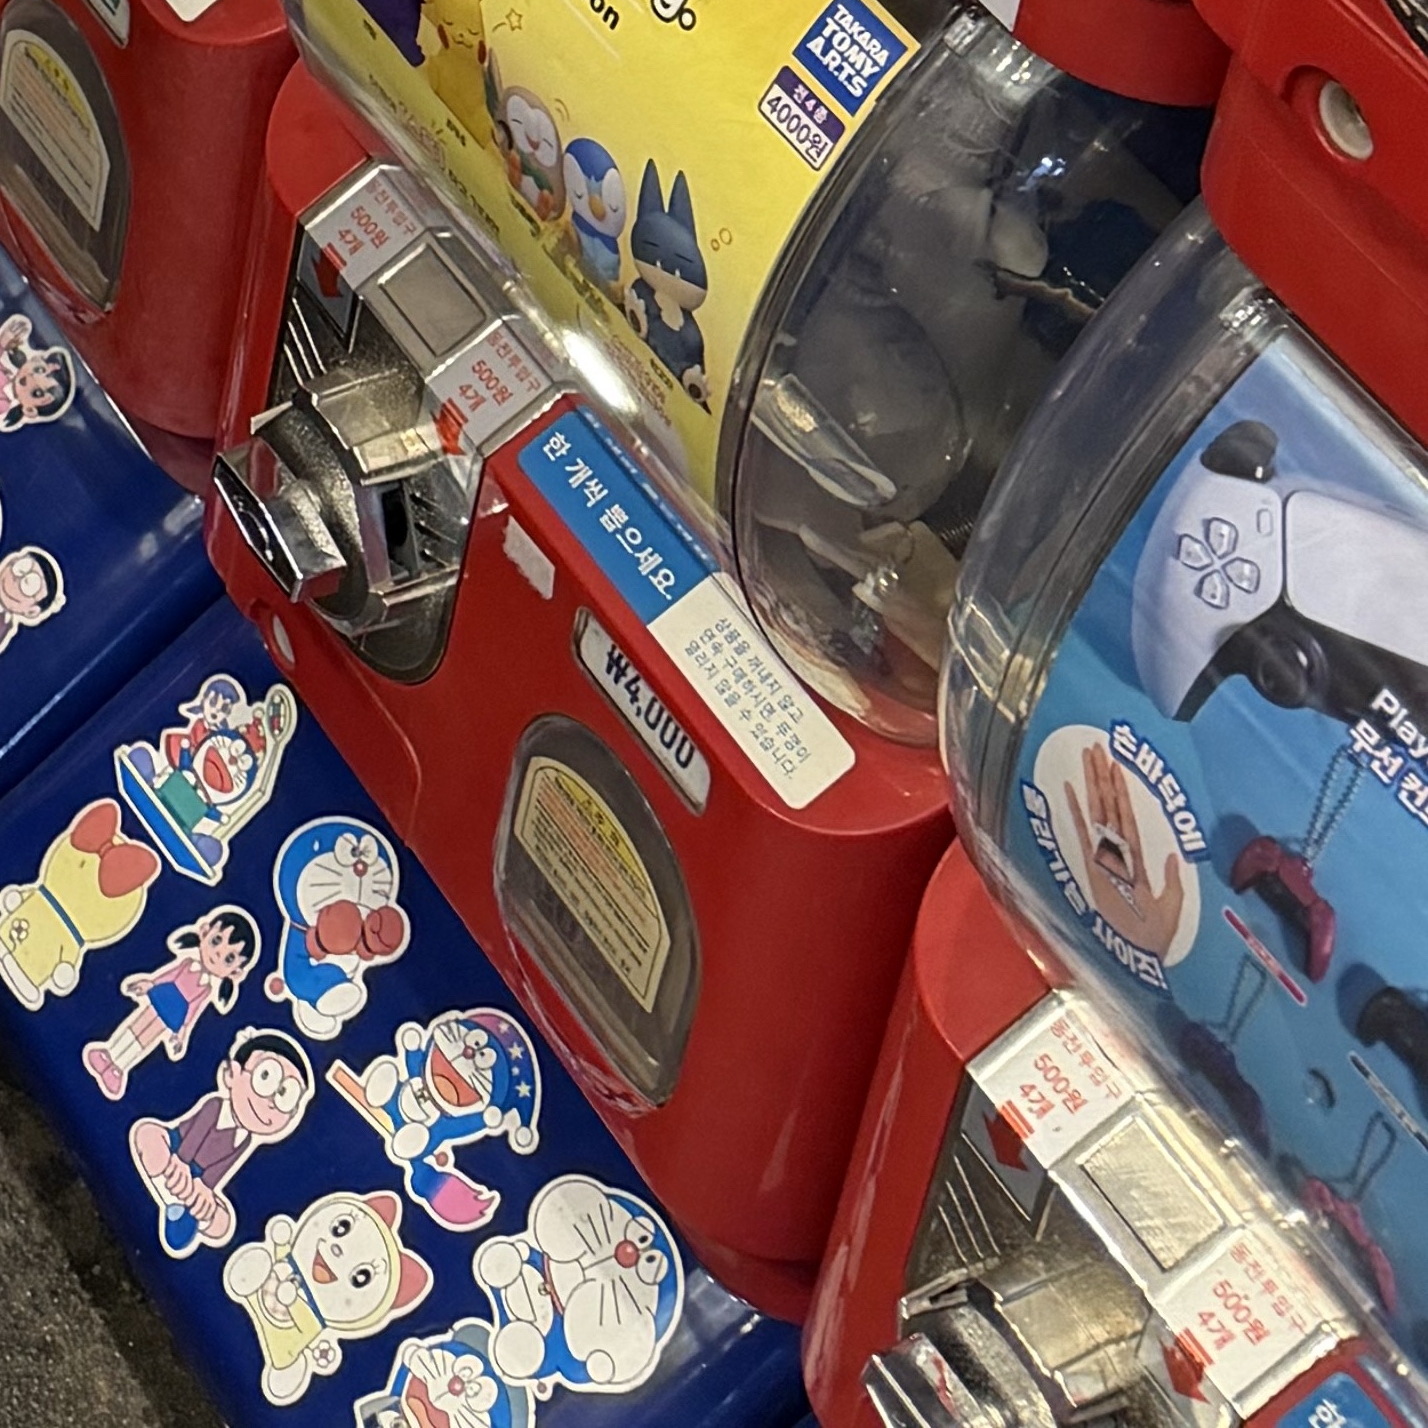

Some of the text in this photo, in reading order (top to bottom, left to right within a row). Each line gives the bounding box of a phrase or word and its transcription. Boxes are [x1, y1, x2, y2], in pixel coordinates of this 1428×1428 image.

[821, 16, 879, 82] TOMY
[833, 3, 889, 66] TAKARA
[765, 92, 830, 167] 4000원
[337, 226, 364, 258] 4개
[350, 204, 391, 251] 500원
[459, 382, 487, 413] 4개
[470, 359, 514, 407] 500원
[542, 432, 677, 601] 한 개씩 뽑으세요.
[606, 643, 696, 770] ₩4,000
[1372, 688, 1428, 760] Play
[1111, 721, 1209, 855] 손바닥에
[1349, 718, 1428, 828] 무선 컨
[1033, 1053, 1089, 1115] 500원
[1210, 1278, 1273, 1348] 500원
